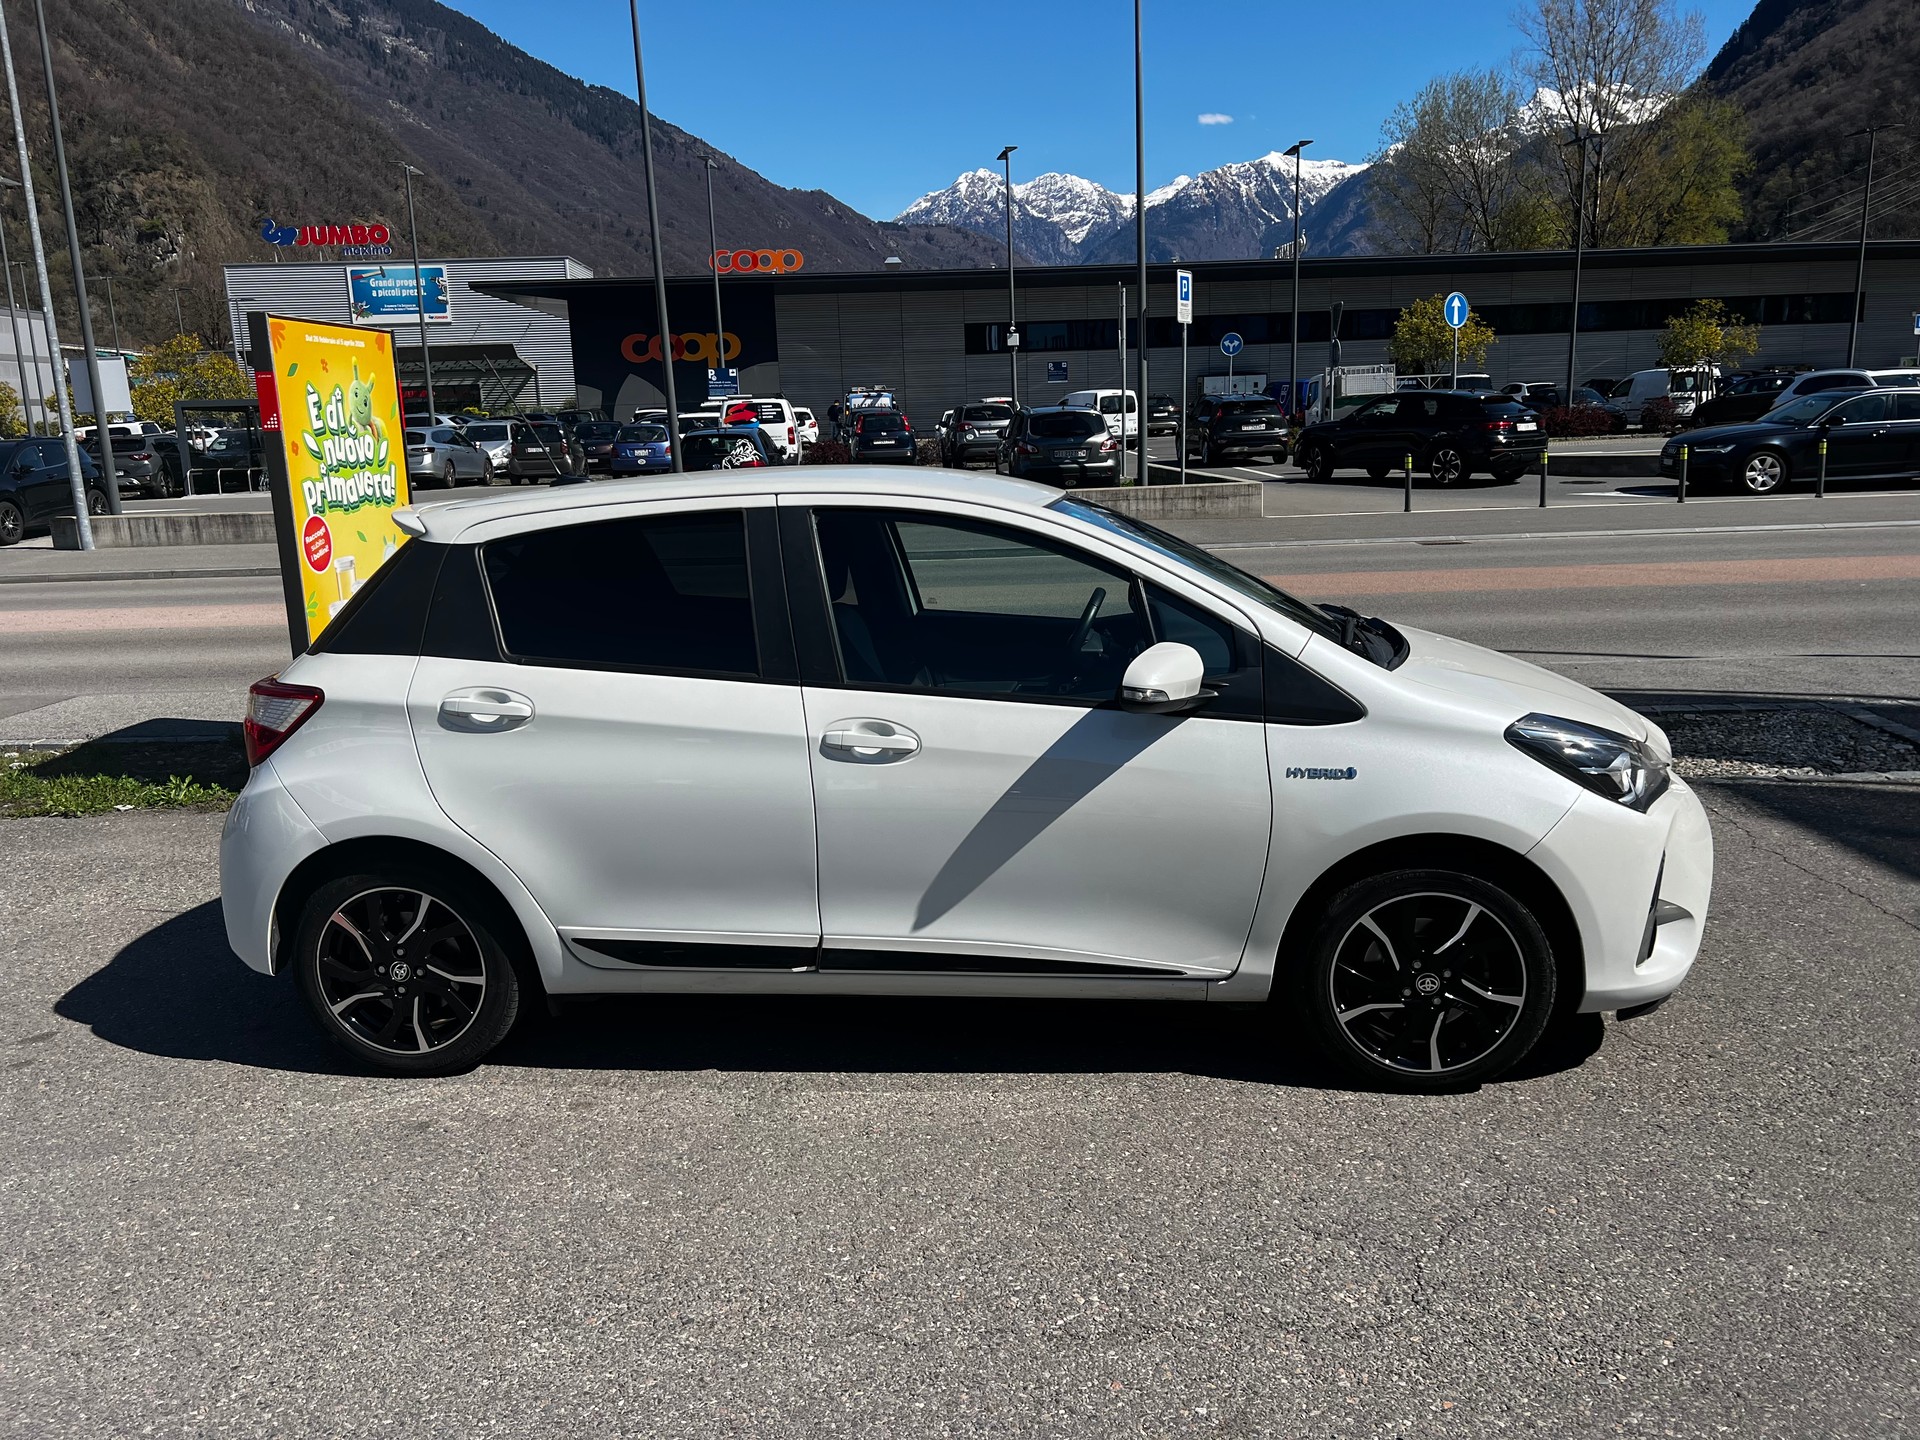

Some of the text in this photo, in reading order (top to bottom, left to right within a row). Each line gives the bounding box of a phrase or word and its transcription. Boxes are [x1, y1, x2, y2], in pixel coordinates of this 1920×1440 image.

[297, 224, 390, 246] JUMBO
[343, 245, 392, 256] maximo
[708, 248, 805, 275] coop
[369, 277, 426, 290] Grandi progeti
[378, 287, 401, 298] piccoli
[402, 286, 427, 298] prezi.
[1182, 279, 1188, 298] P
[620, 332, 742, 369] coop
[708, 369, 715, 379] P
[326, 387, 347, 434] di
[322, 434, 375, 468] nuovo
[302, 463, 396, 515] primavera!
[305, 525, 326, 544] Raccogli
[1286, 767, 1346, 780] HYBRID
